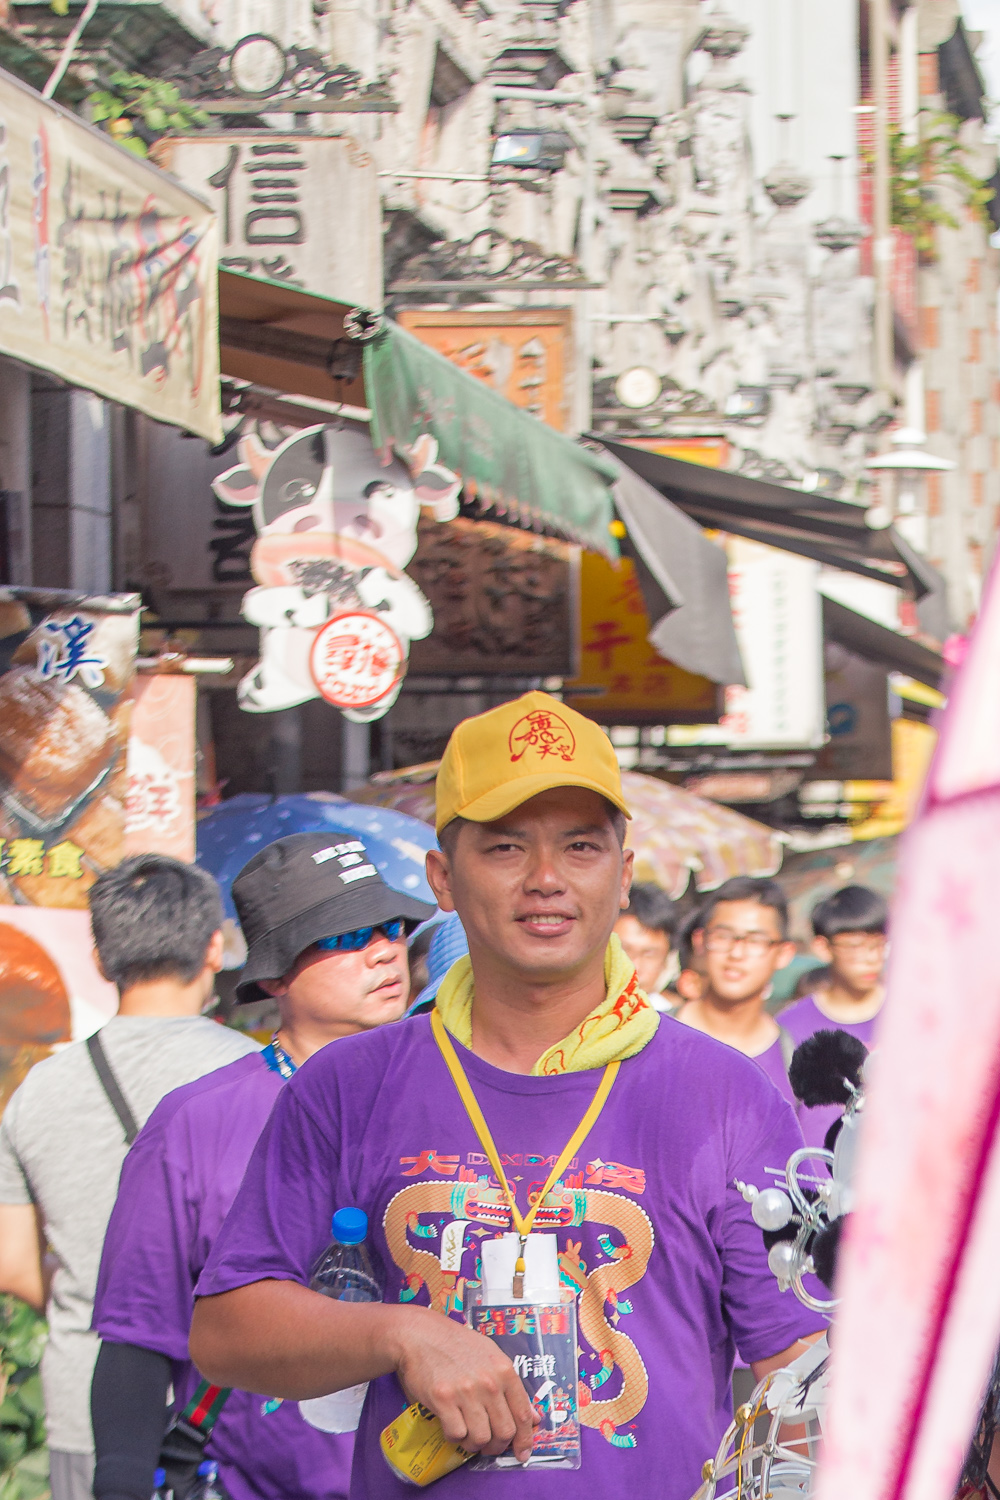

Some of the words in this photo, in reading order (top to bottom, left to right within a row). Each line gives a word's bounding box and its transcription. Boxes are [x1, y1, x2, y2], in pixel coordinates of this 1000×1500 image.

[46, 614, 105, 688] 溪
[0, 837, 85, 880] 素食
[400, 1150, 460, 1176] 大
[513, 1354, 557, 1379] 作證
